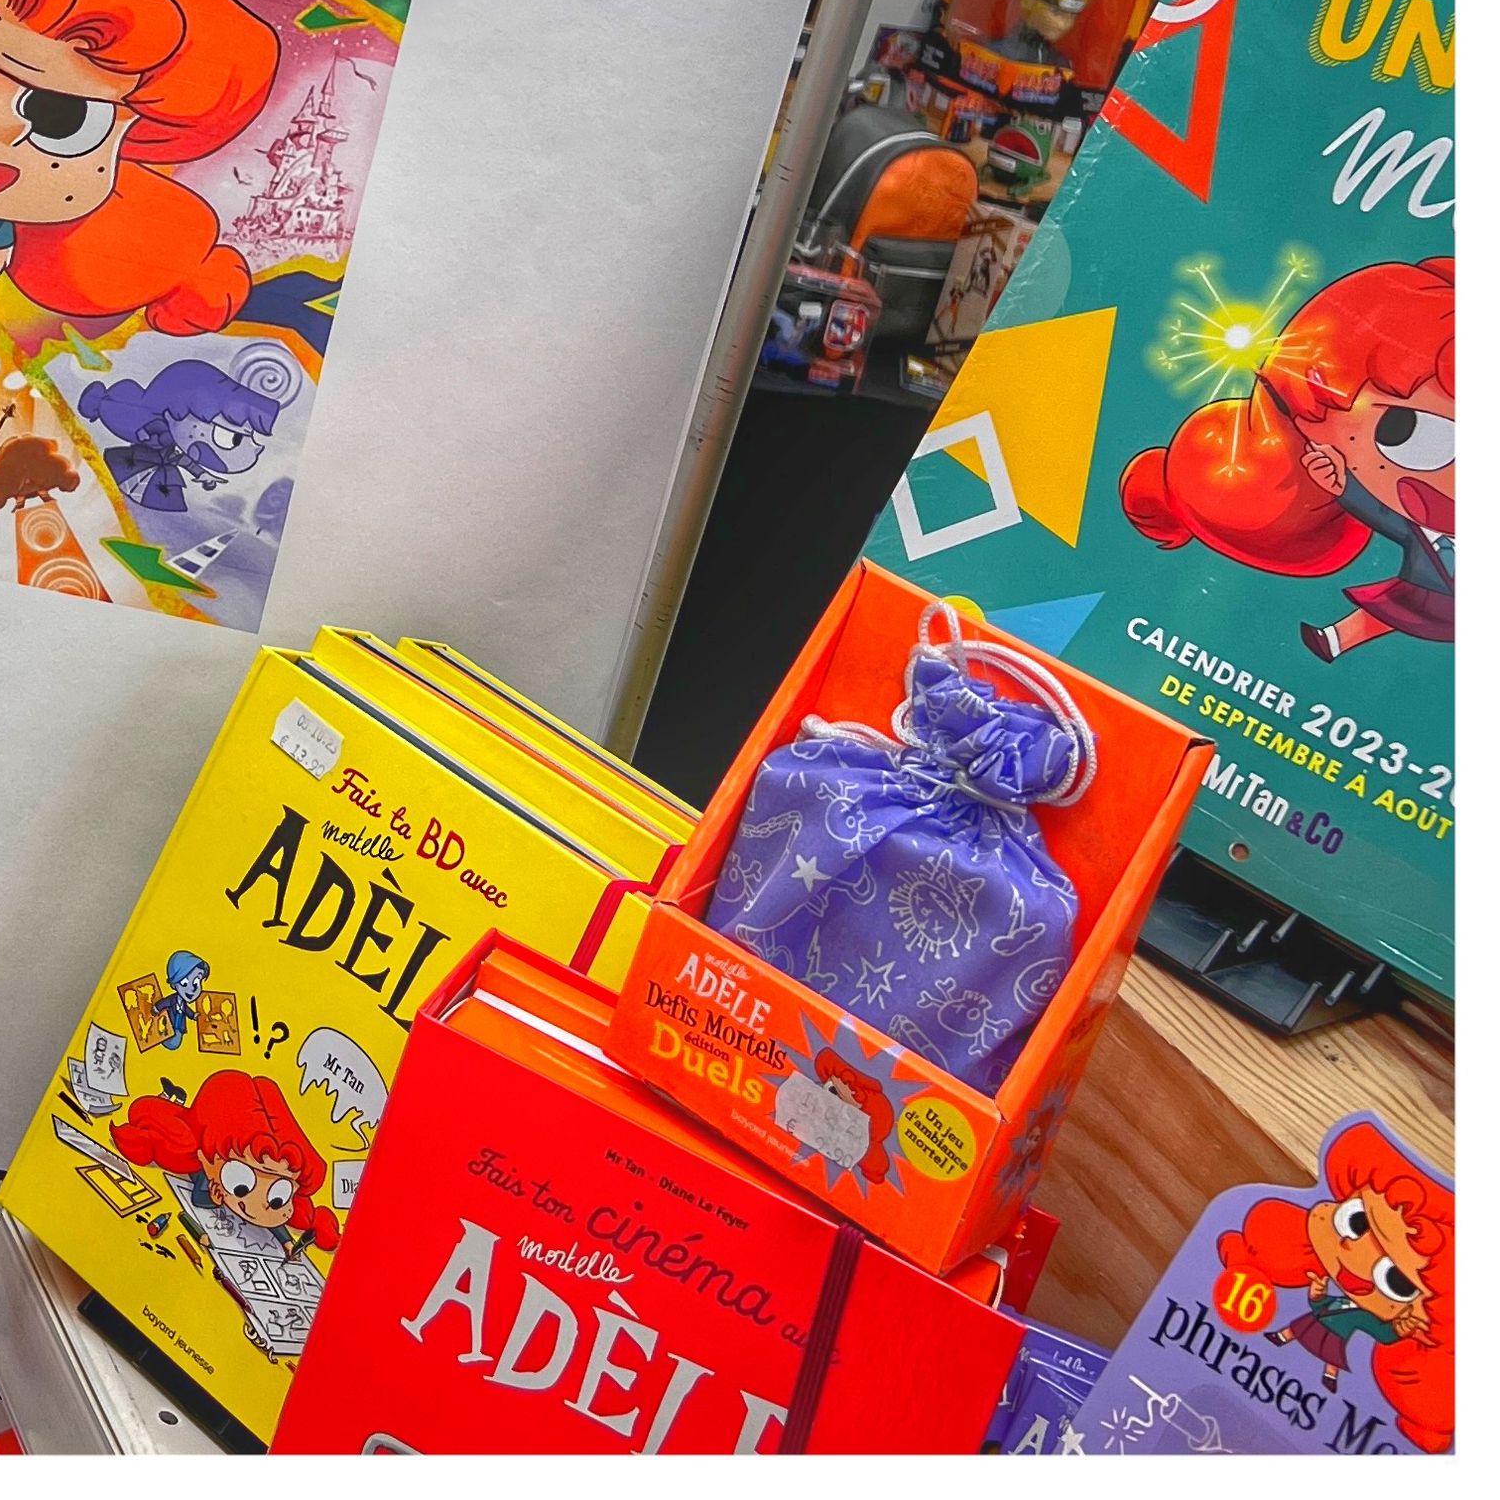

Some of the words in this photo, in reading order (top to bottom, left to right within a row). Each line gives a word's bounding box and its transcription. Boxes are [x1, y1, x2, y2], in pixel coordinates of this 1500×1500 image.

[1126, 617, 1297, 718] CALENDRIER
[1301, 703, 1456, 809] 2023-2
[1159, 675, 1198, 707] DE
[1199, 694, 1345, 784] SEPTEMBRE
[1344, 767, 1371, 800] À
[321, 820, 405, 862] mortelle
[331, 767, 382, 818] Fais
[390, 807, 412, 840] ta
[416, 817, 466, 870] BD
[460, 868, 508, 909] avec
[644, 980, 699, 1028] Défis
[701, 1009, 788, 1071] Mortels
[651, 1019, 764, 1106] Duels
[684, 1031, 730, 1062] édition
[323, 1052, 345, 1076] Mr
[343, 1066, 366, 1095] Tan
[904, 1110, 969, 1172] d'ambiance
[904, 1128, 949, 1169] mortel
[925, 1108, 943, 1131] Un
[940, 1126, 965, 1150] jeu
[604, 1149, 623, 1165] Mr
[624, 1158, 645, 1178] Tan
[658, 1176, 696, 1204] Diane
[697, 1197, 714, 1214] Le
[715, 1206, 750, 1231] Feyer
[468, 1147, 525, 1198] Fais
[531, 1177, 576, 1226] ton
[585, 1201, 776, 1326] cinéma
[517, 1235, 635, 1284] mortelle
[1219, 1270, 1273, 1323] 16
[142, 1304, 177, 1340] bayard
[173, 1334, 215, 1375] jeunesse
[401, 1218, 789, 1455] ADÈL
[1148, 1296, 1329, 1431] phrases
